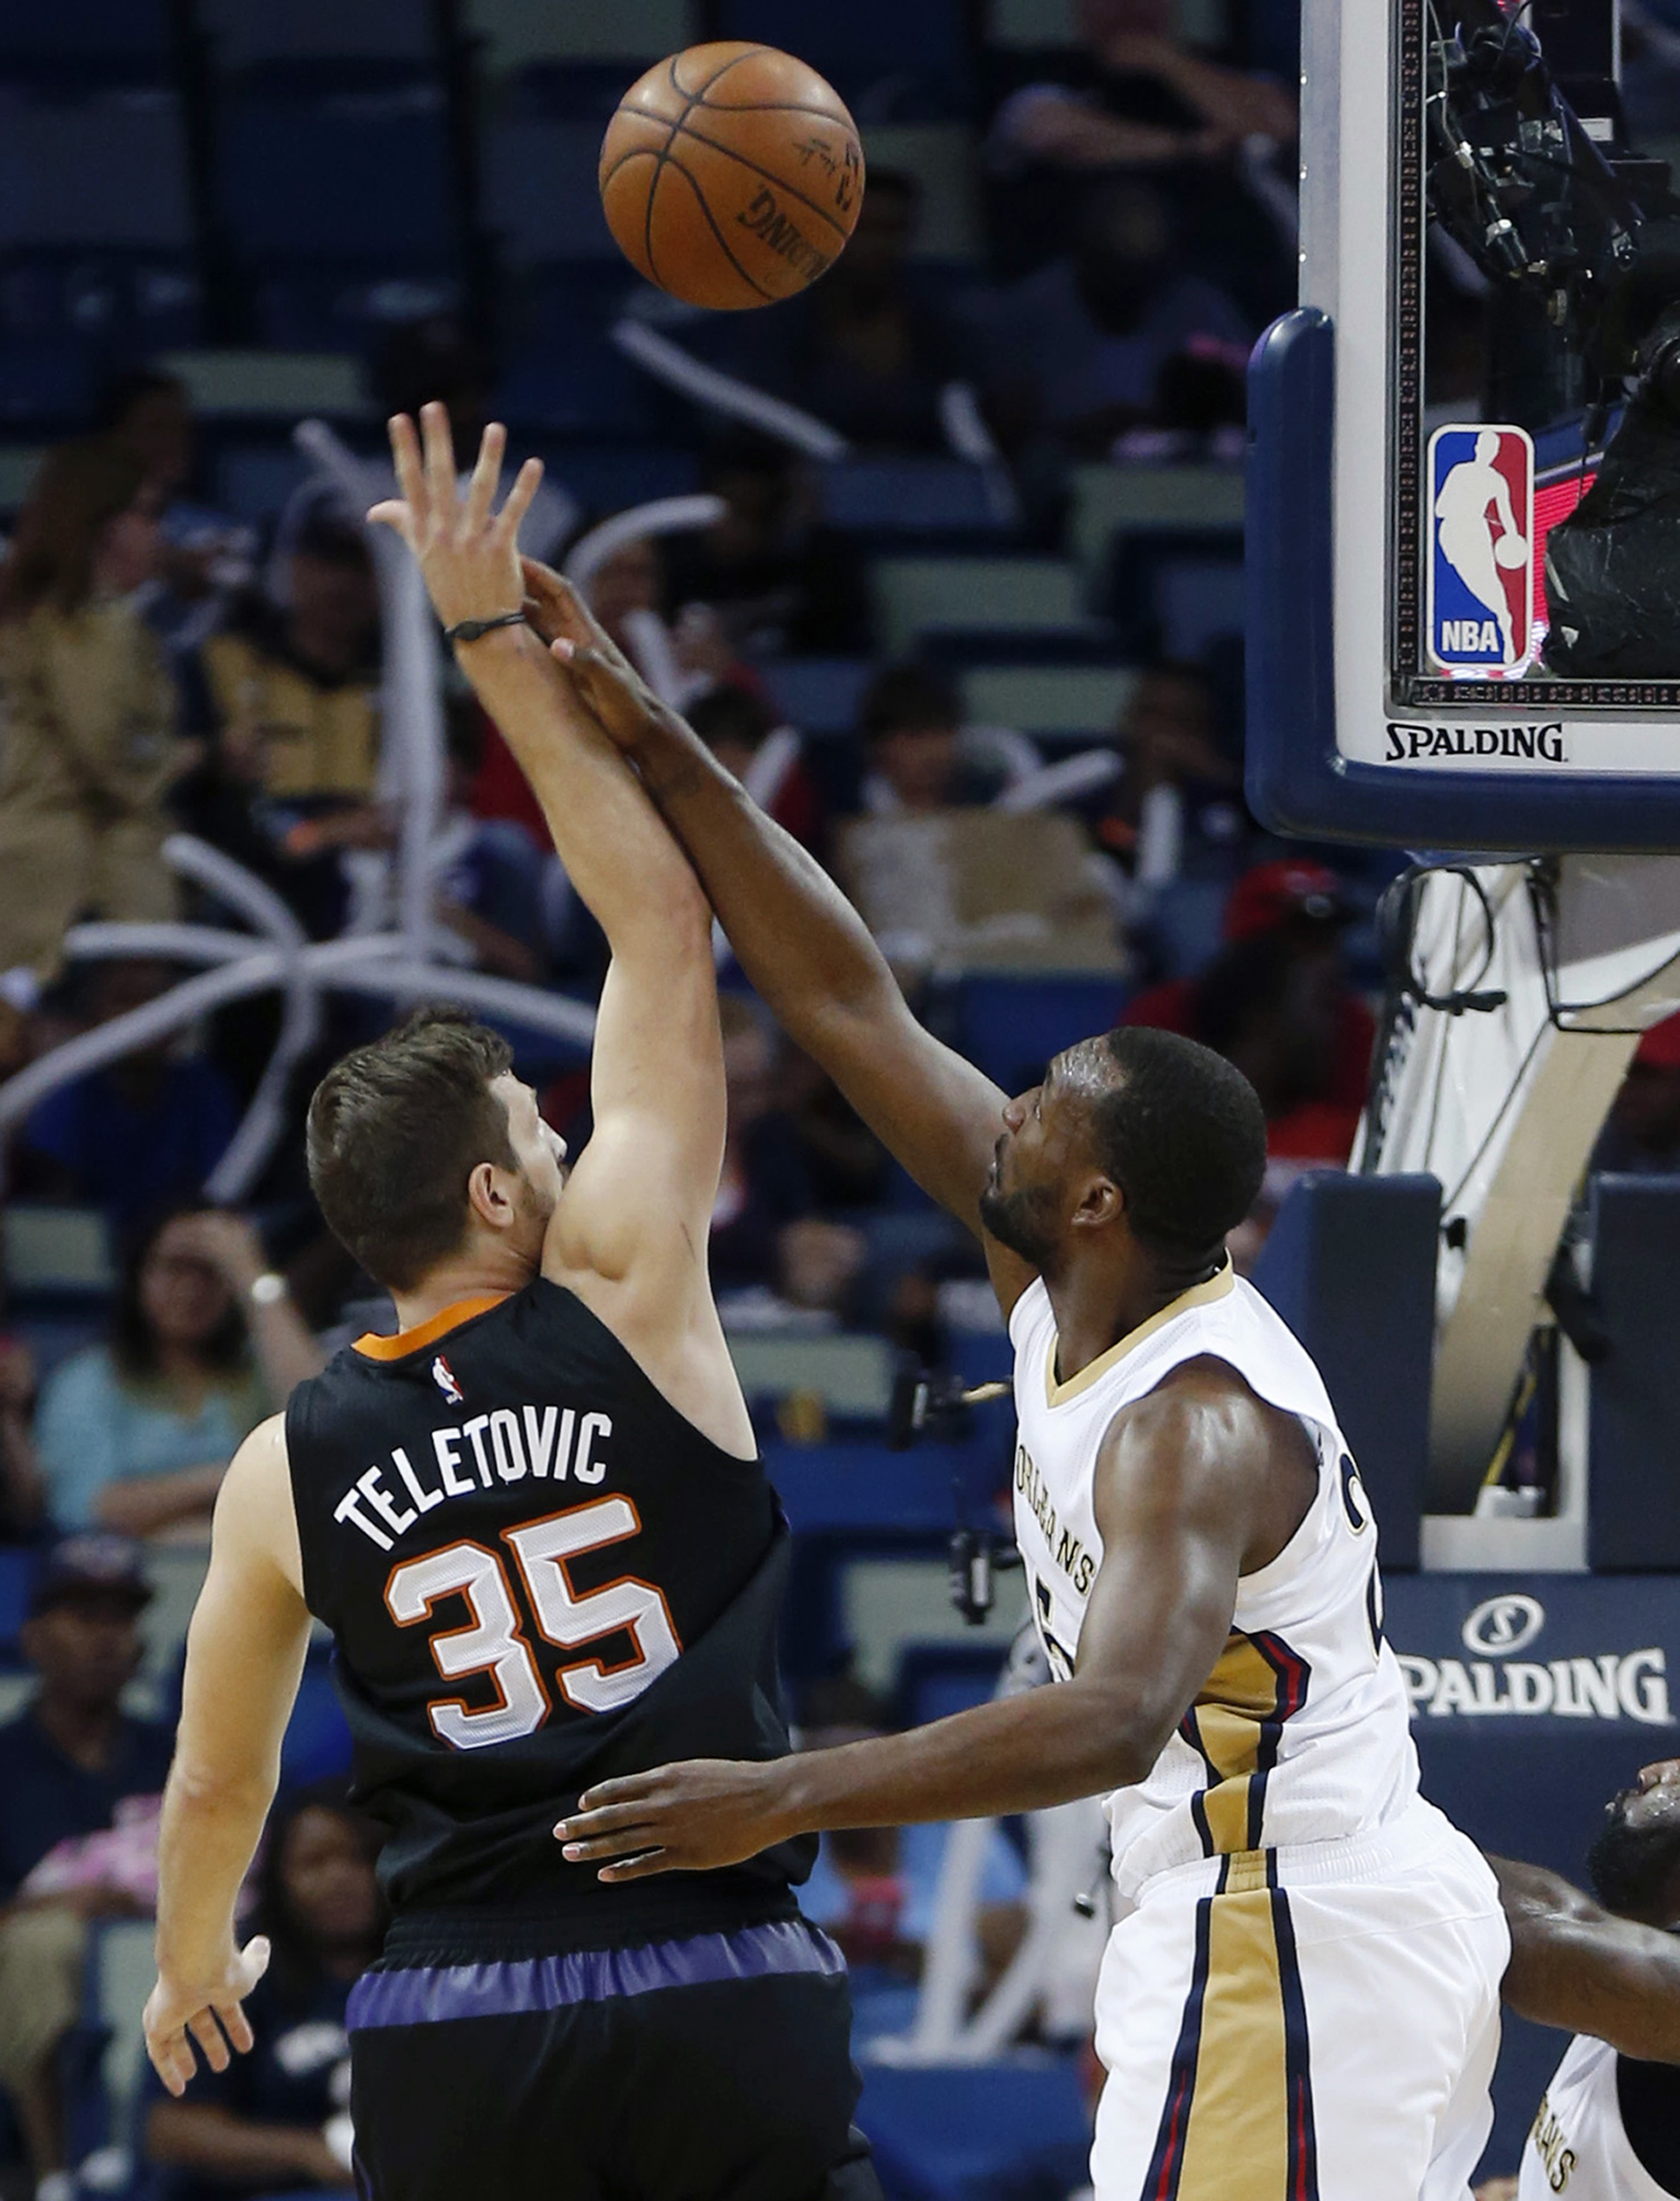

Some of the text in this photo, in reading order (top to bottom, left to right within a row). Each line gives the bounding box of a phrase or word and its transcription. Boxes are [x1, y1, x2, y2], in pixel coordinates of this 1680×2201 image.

[1441, 620, 1500, 652] NBA
[1385, 722, 1563, 763] SPALDING
[333, 1405, 613, 1551] TELETOVIC
[383, 1491, 684, 1751] 35
[1396, 1647, 1672, 1726] PALDING
